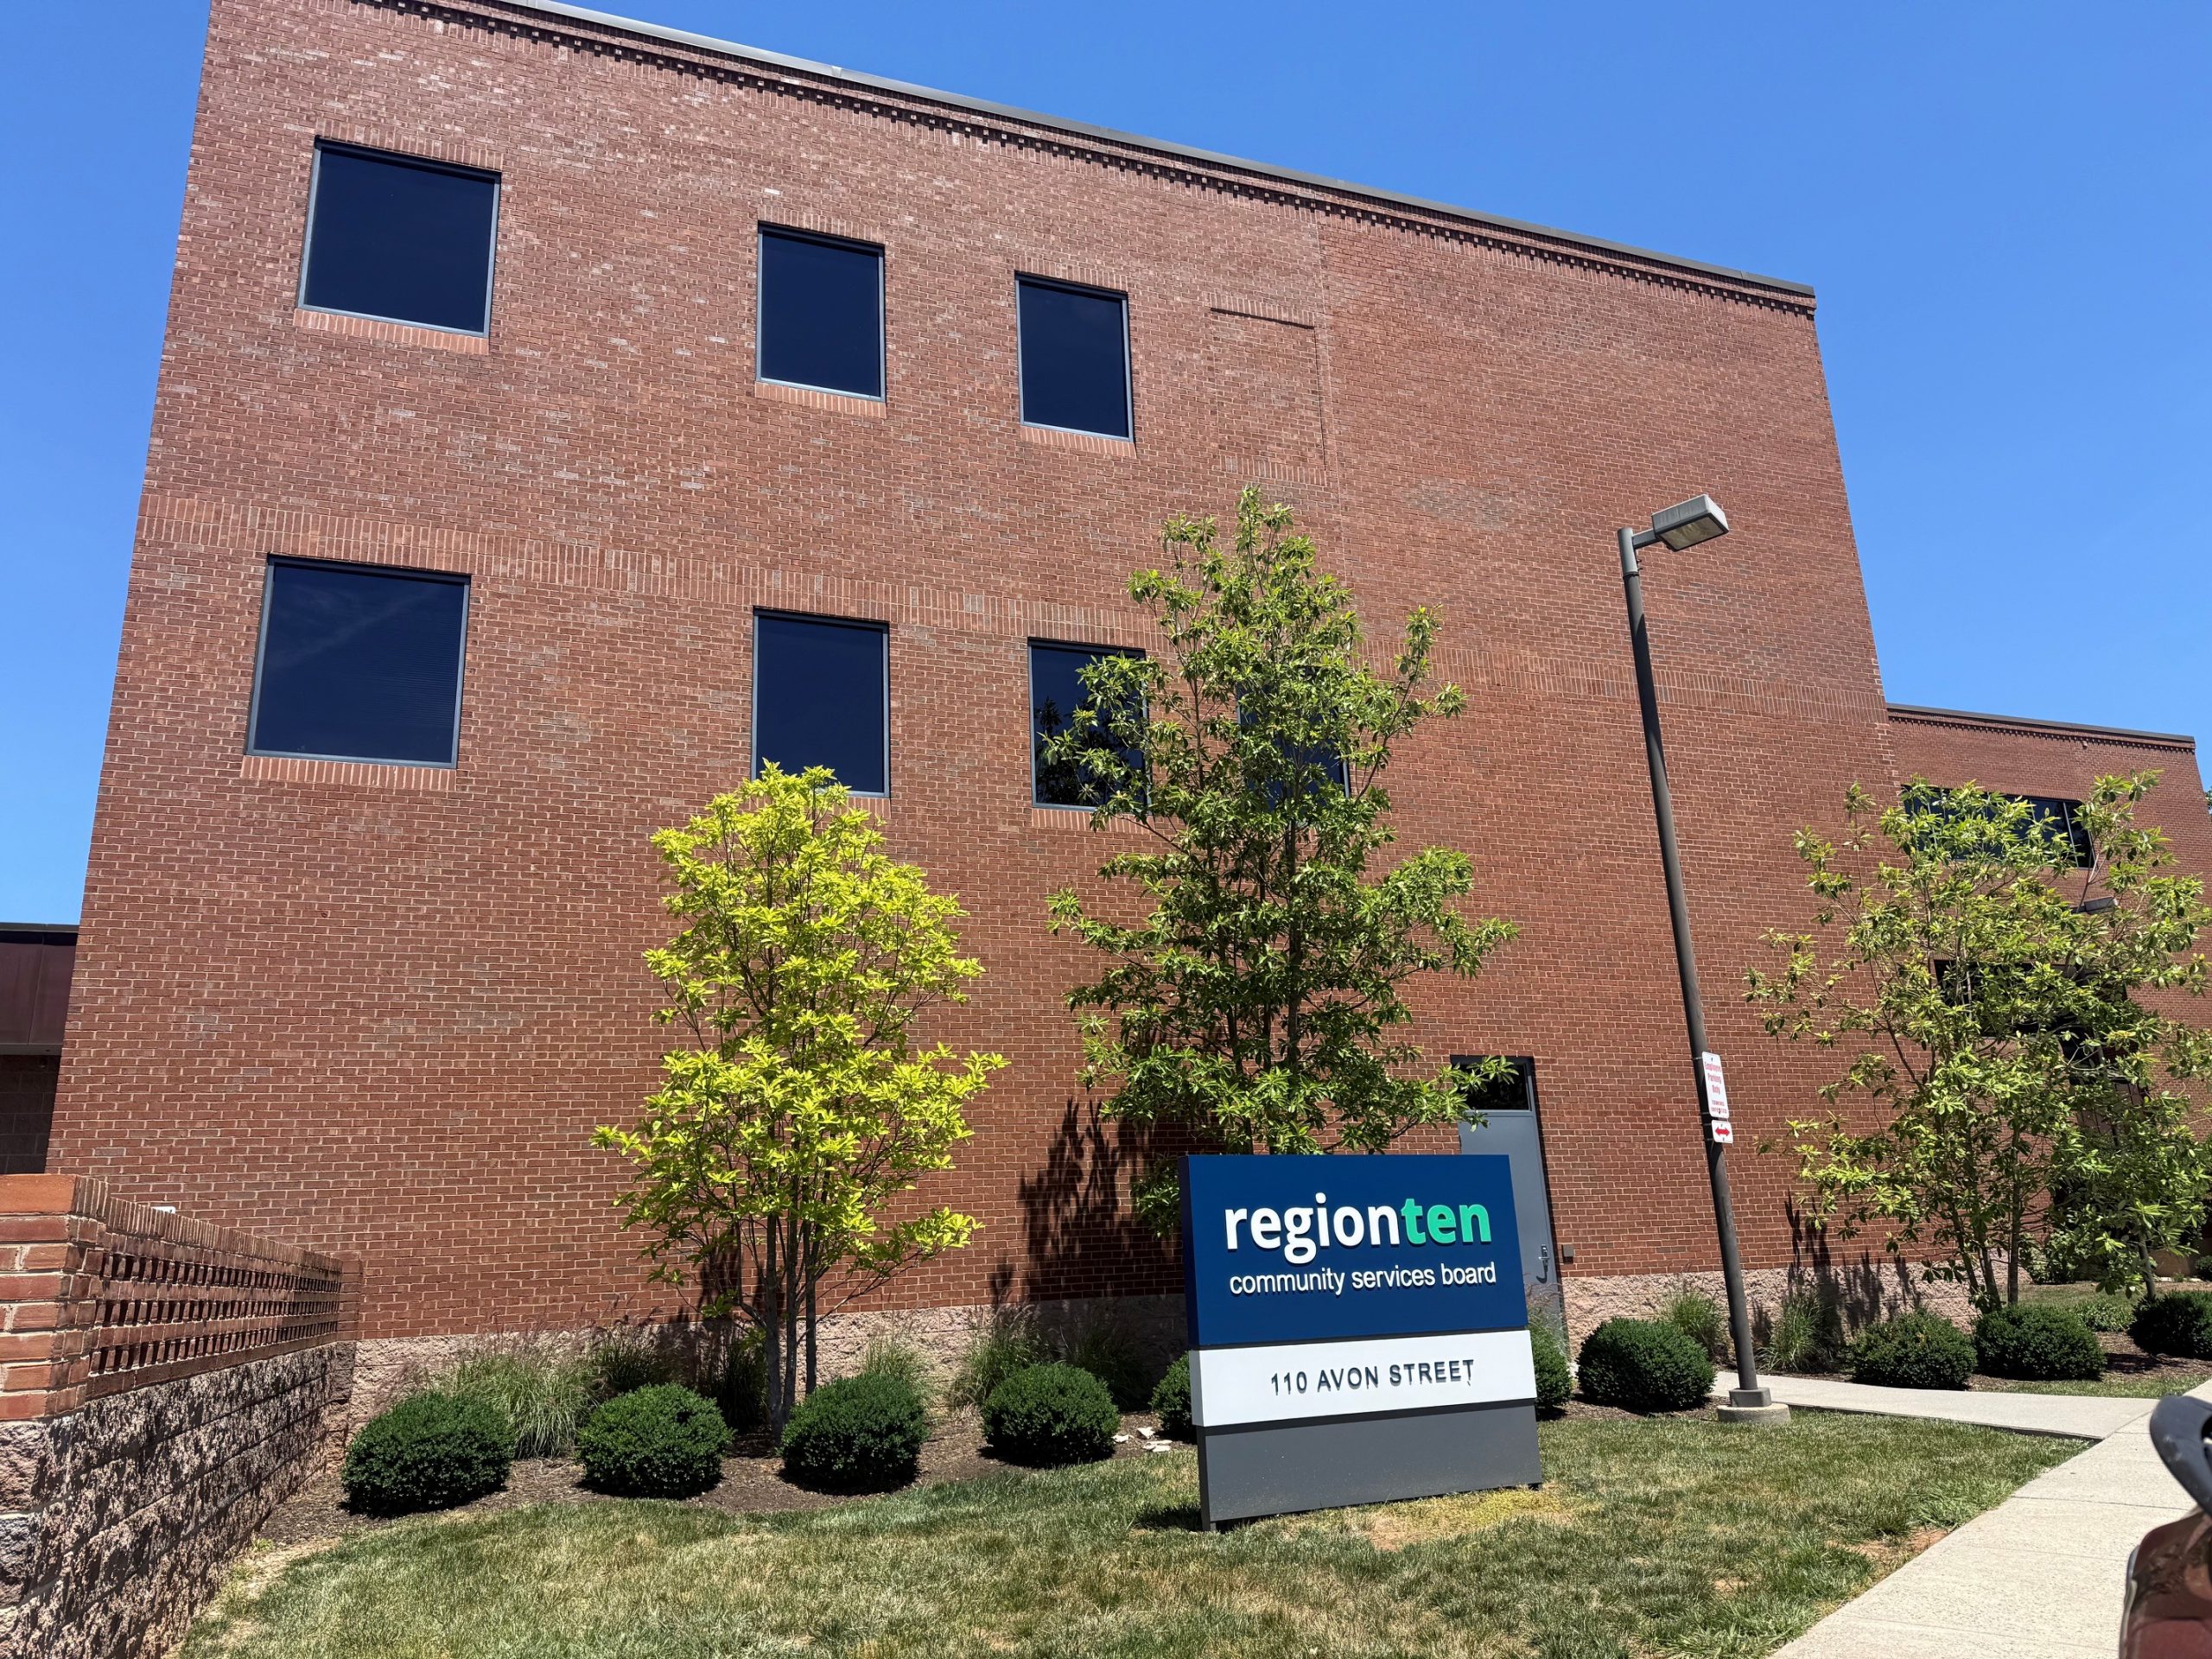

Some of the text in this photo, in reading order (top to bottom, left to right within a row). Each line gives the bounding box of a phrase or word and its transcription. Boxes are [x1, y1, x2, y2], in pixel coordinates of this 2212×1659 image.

[1224, 1192, 1491, 1264] regionten
[1230, 1262, 1497, 1296] community services board
[1270, 1359, 1474, 1395] 110 AVON STREET
